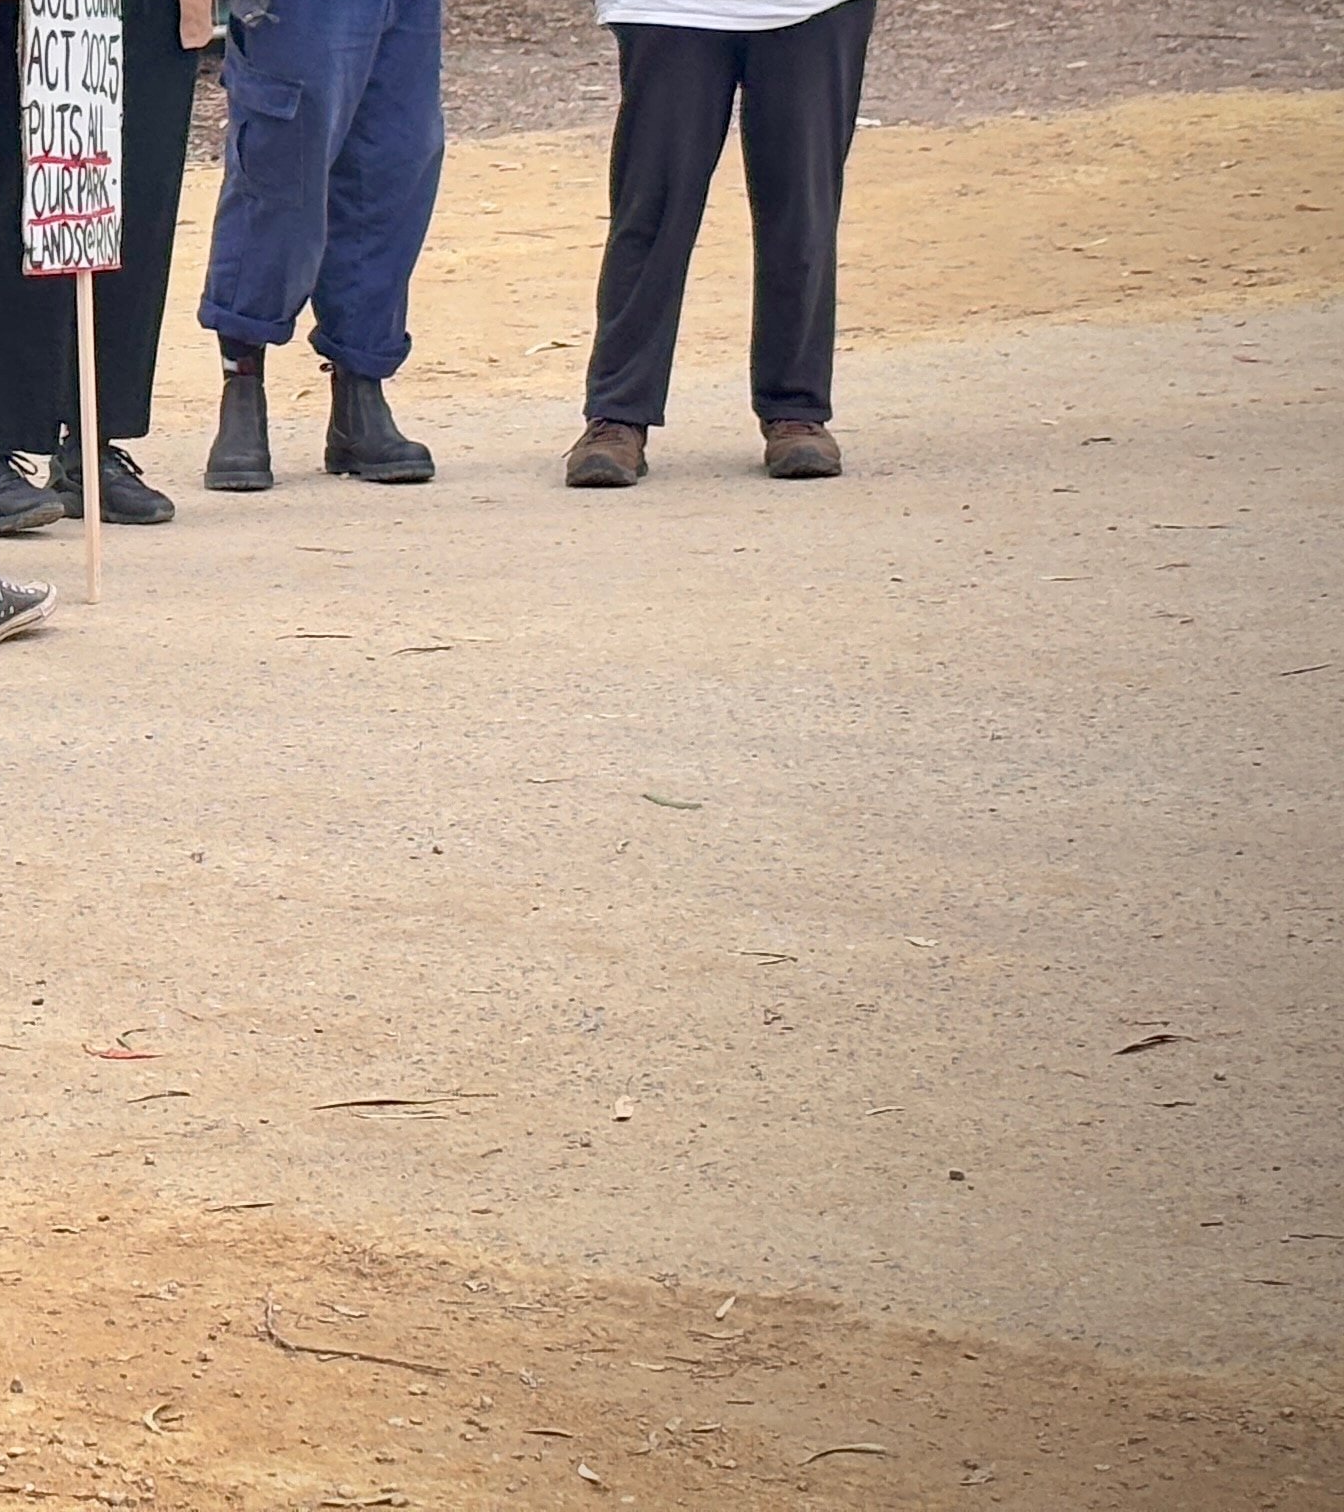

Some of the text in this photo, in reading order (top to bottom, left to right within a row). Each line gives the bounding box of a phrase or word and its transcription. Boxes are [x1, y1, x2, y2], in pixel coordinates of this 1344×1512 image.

[27, 25, 120, 104] ACT 2025
[27, 100, 108, 159] PUTS ALL
[31, 164, 75, 219] OUR
